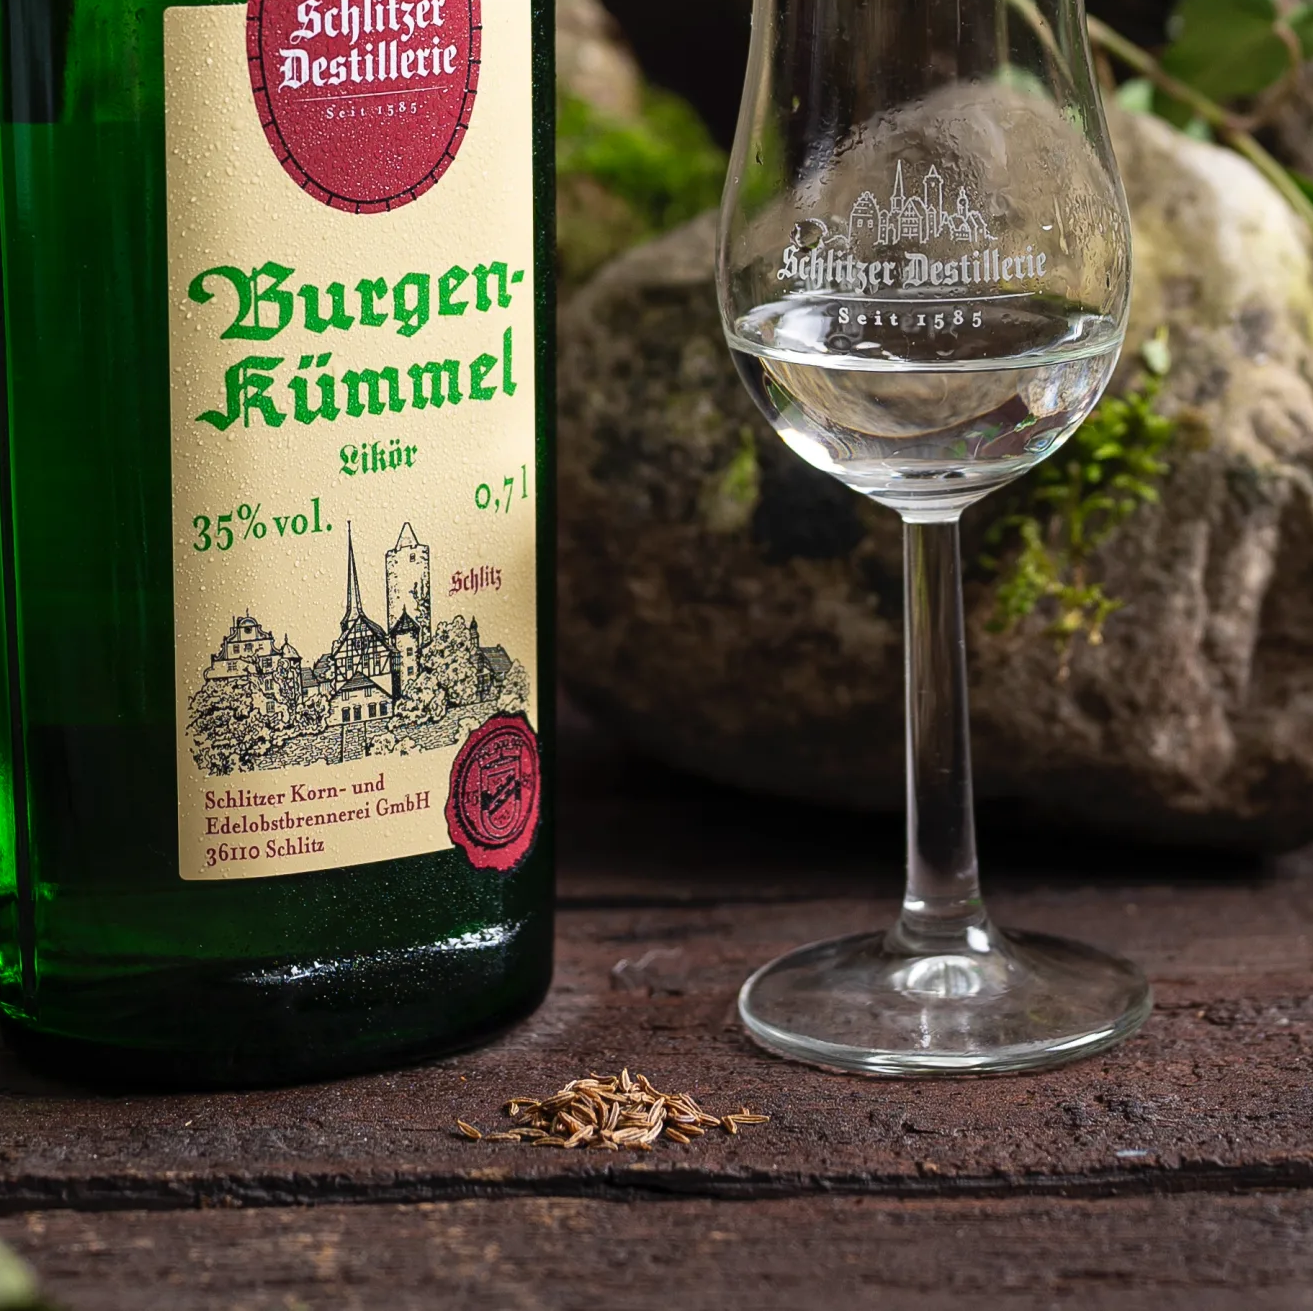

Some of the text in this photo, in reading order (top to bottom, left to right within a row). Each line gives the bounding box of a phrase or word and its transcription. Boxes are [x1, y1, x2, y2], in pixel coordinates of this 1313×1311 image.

[278, 36, 458, 93] Destillerie
[326, 101, 417, 119] Seit 1585
[777, 243, 1048, 294] Schlitzer Destillerie
[188, 261, 525, 341] Burgen-
[838, 306, 983, 330] Seit 1585
[194, 326, 518, 432] Kümmel
[338, 439, 418, 476] Likör
[192, 497, 333, 552] 35% vol.
[448, 565, 502, 596] Schlitz
[204, 772, 385, 810] Schlitzer Korn- und
[205, 790, 431, 836] Edelobstbrennerei GmbH
[206, 836, 325, 867] 36110 Schlitz
